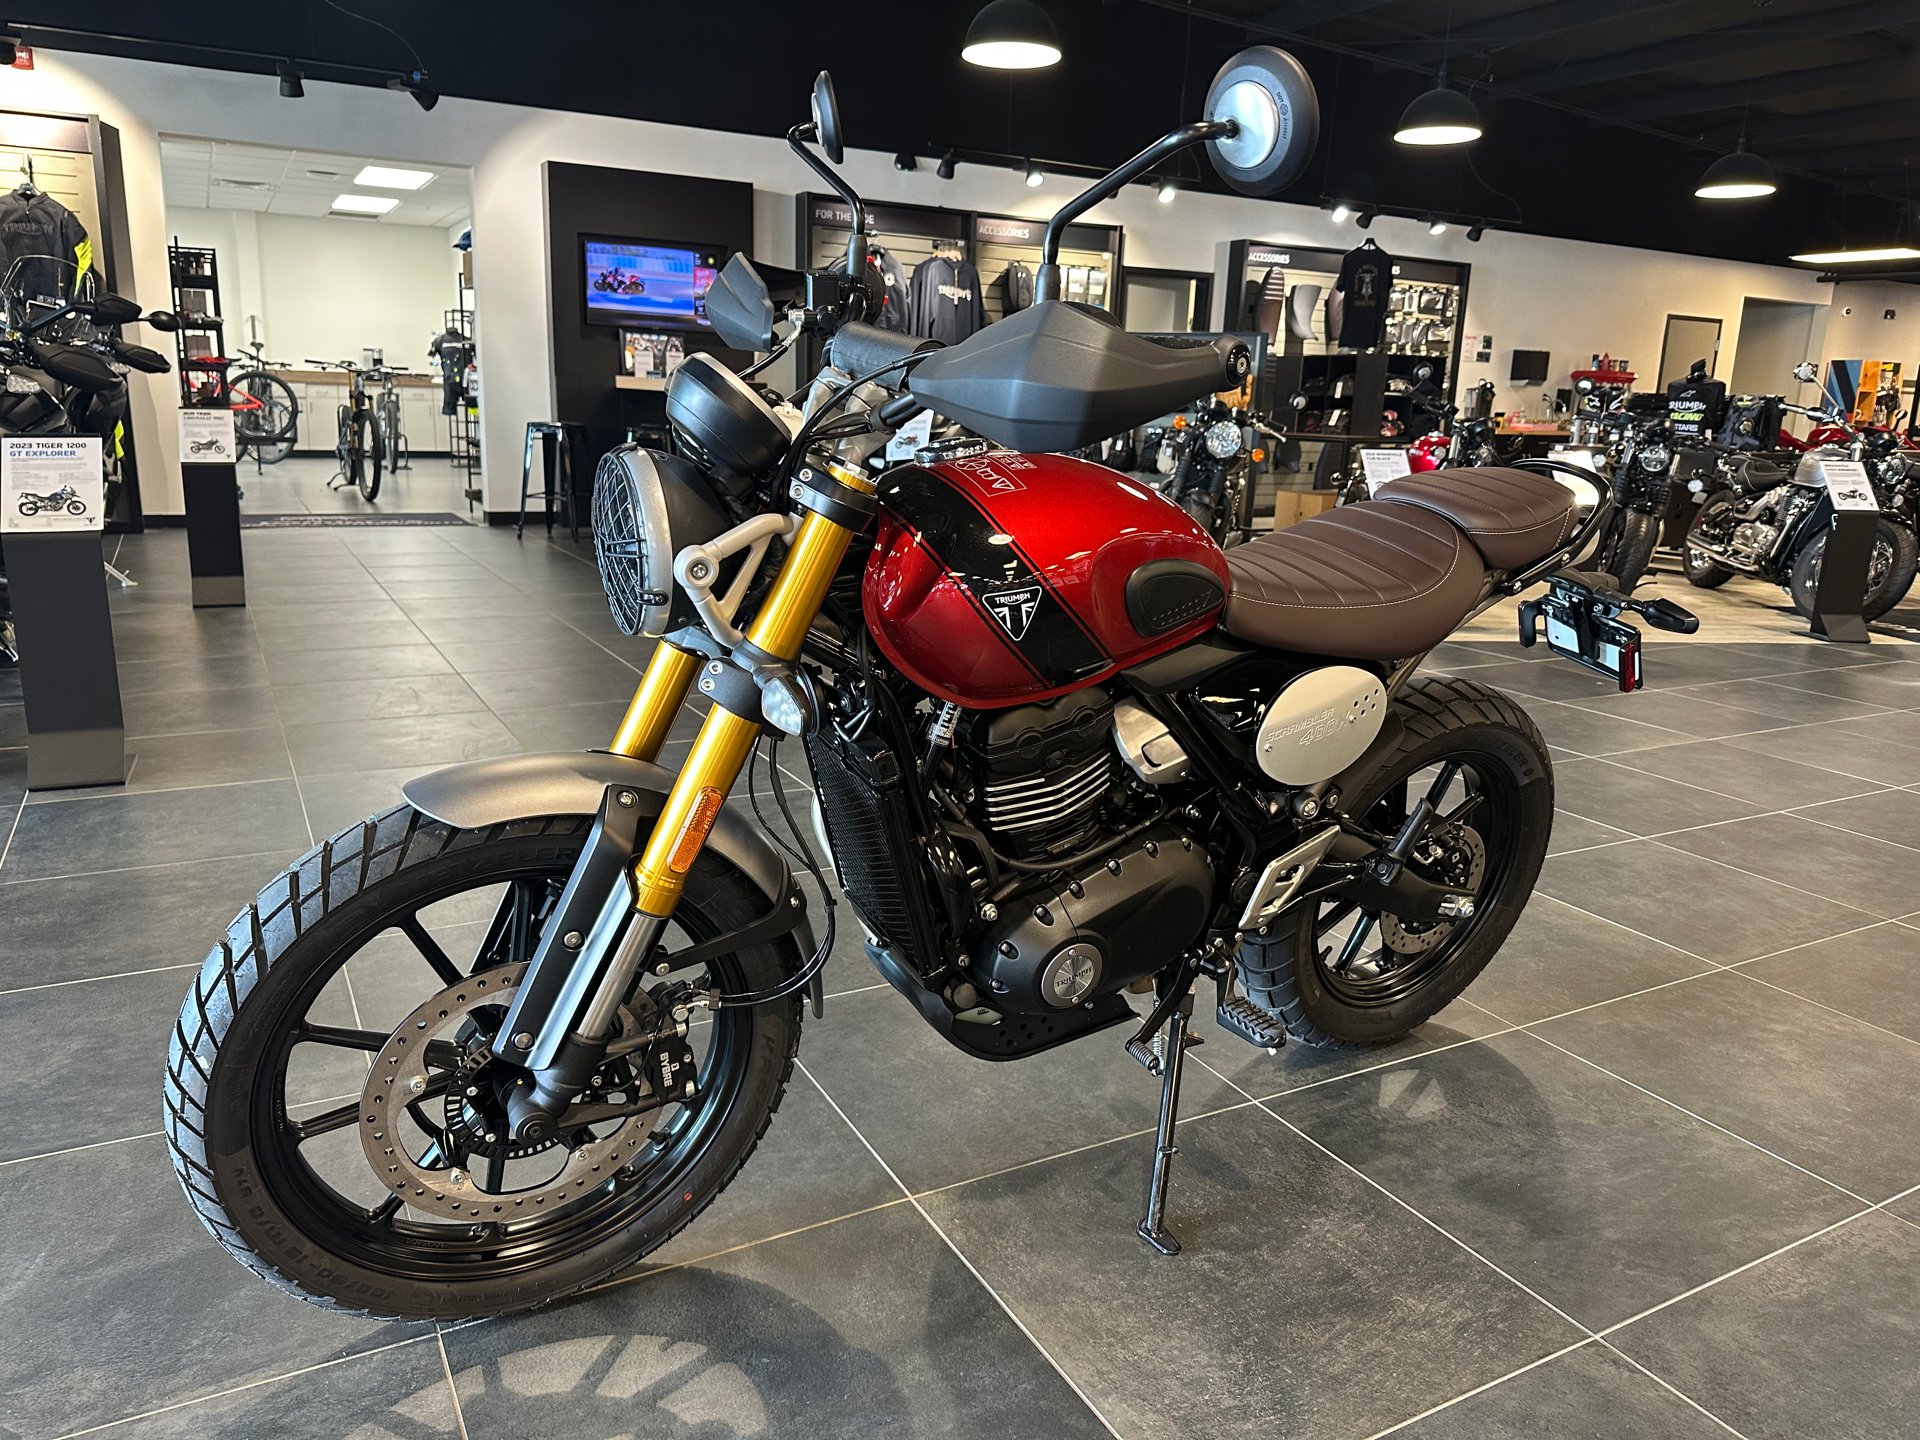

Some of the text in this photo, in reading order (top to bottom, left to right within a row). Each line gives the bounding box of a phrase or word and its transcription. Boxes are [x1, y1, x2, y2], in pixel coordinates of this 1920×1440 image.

[815, 209, 834, 220] FOR
[835, 211, 852, 222] THE
[3, 222, 53, 235] TRIUMPH
[979, 225, 1030, 239] ACCESSORIES
[1248, 252, 1290, 264] ACCESSORIES
[994, 592, 1031, 605] TRIUMPH
[1266, 707, 1335, 743] SCRAMBLER
[1056, 966, 1092, 987] TRIUMPH
[660, 1051, 673, 1088] BYBRE
